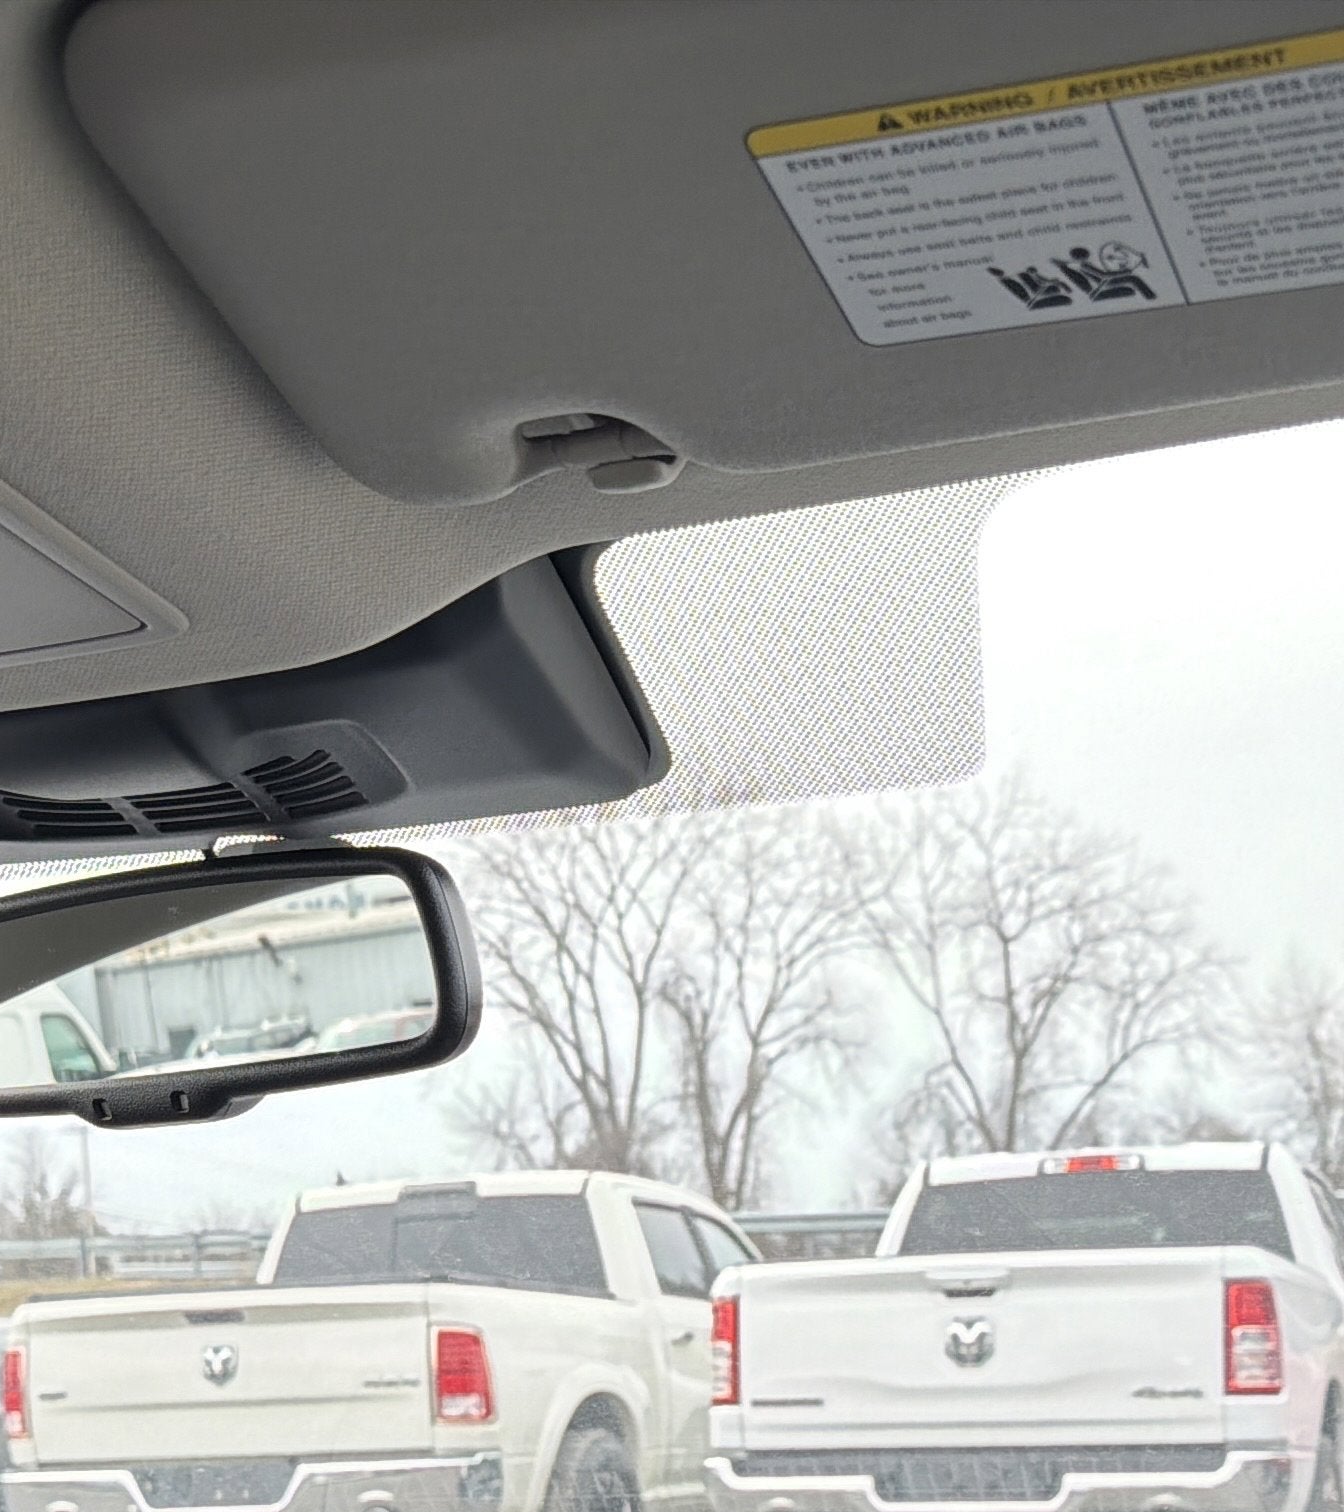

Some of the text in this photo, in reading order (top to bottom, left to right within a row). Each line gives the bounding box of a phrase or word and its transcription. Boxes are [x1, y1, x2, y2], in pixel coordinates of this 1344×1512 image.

[907, 49, 1285, 125] WARNING AVERTISSEMENT
[837, 148, 884, 163] WITH
[890, 129, 990, 155] ADVANCED
[997, 124, 1028, 139] AIR
[1033, 115, 1087, 133] BAGS
